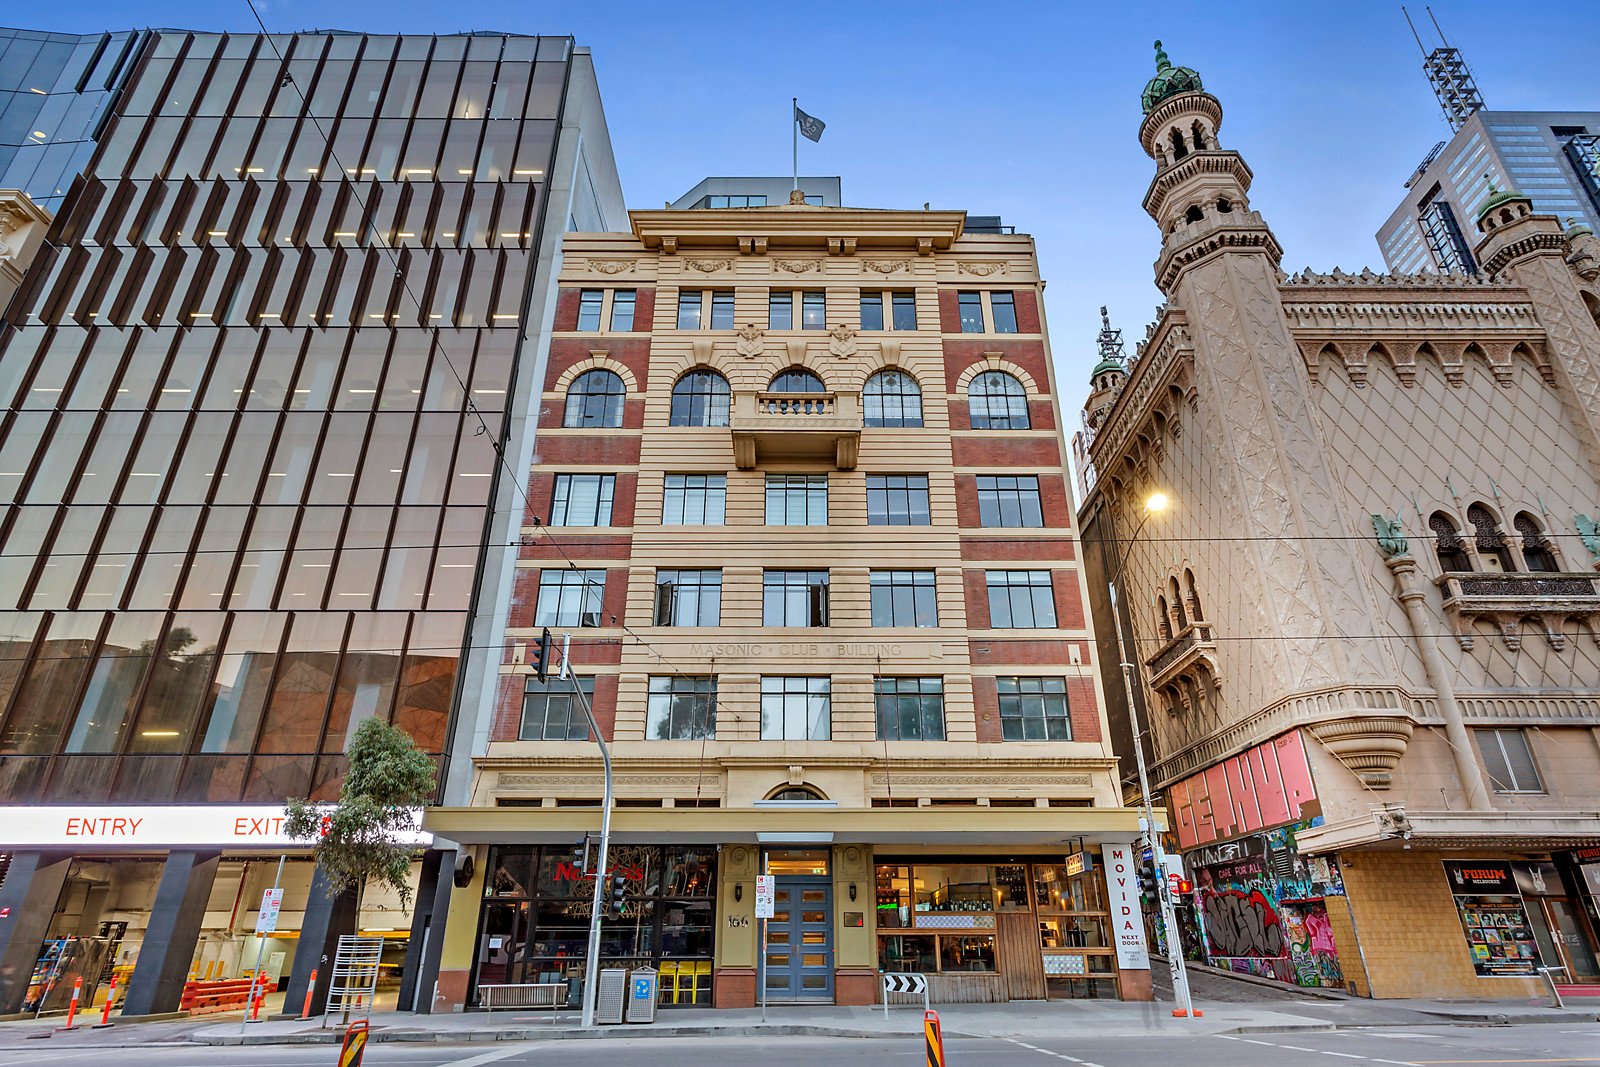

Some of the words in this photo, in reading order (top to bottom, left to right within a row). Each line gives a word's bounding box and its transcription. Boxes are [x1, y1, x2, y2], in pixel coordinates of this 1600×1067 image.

[689, 644, 762, 656] MASONIC
[779, 644, 818, 655] CLUB
[837, 644, 902, 656] BUILDING
[65, 817, 143, 836] ENTRY
[234, 817, 285, 836] EXIT
[381, 820, 421, 834] arking
[1577, 847, 1600, 859] FORU
[1218, 867, 1232, 879] CARE
[1234, 865, 1247, 876] FOR
[1249, 863, 1262, 874] ALL
[1462, 869, 1506, 880] FORUM
[1112, 850, 1133, 930] MOVIDA
